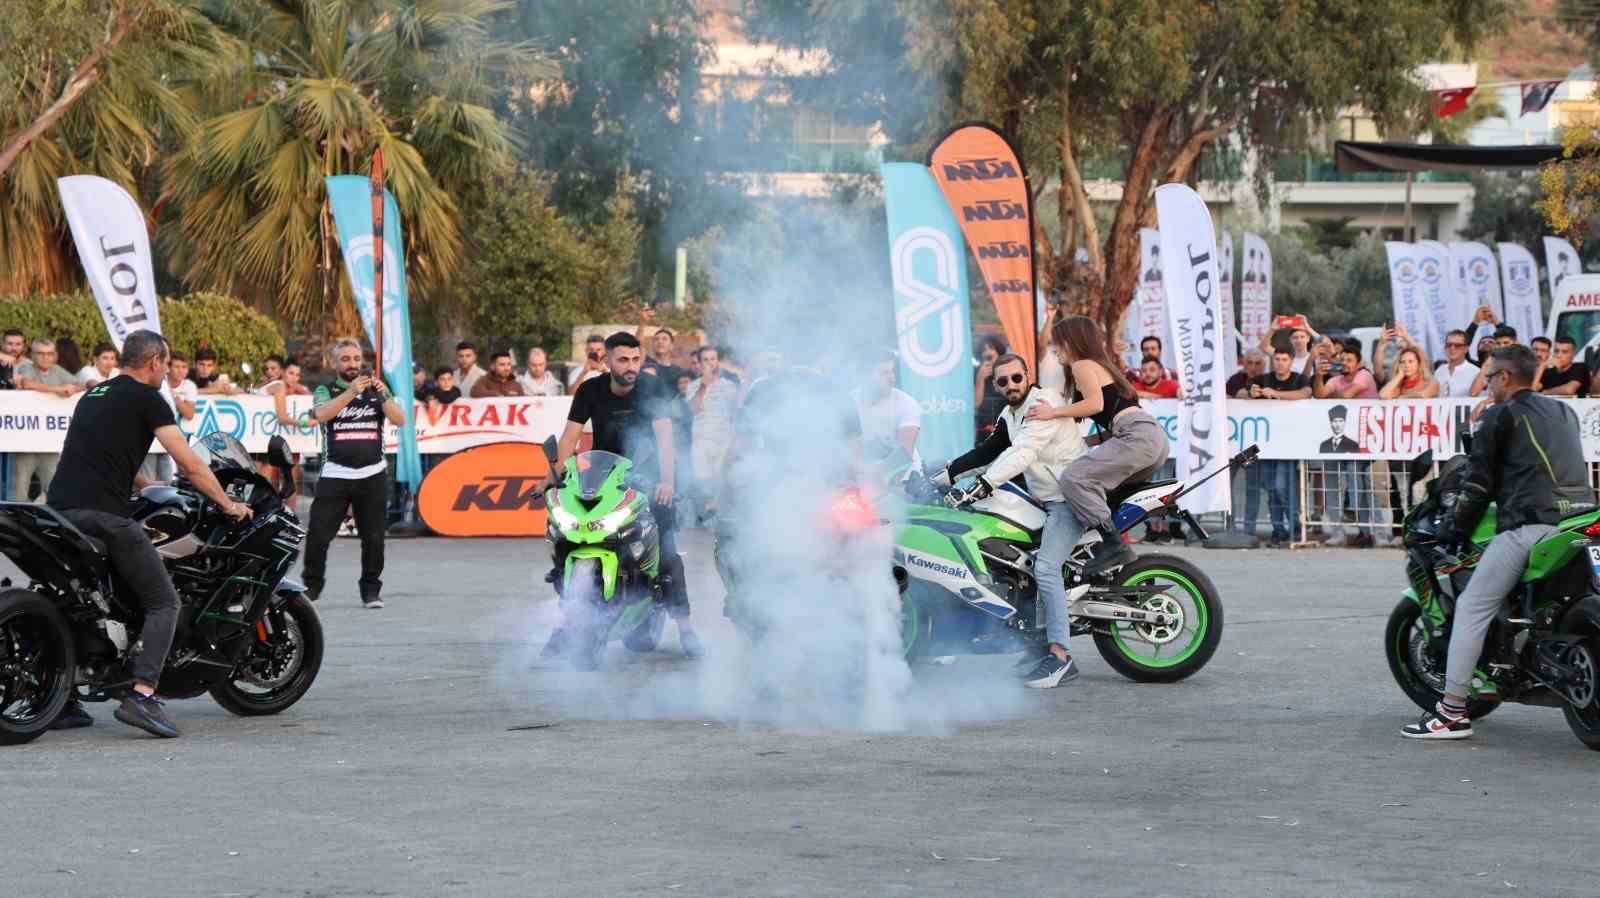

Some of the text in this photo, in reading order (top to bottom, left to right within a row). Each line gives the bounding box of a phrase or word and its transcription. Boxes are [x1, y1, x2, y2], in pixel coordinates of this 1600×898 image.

[0, 415, 73, 430] RUM BE
[907, 553, 968, 579] Kawasaki
